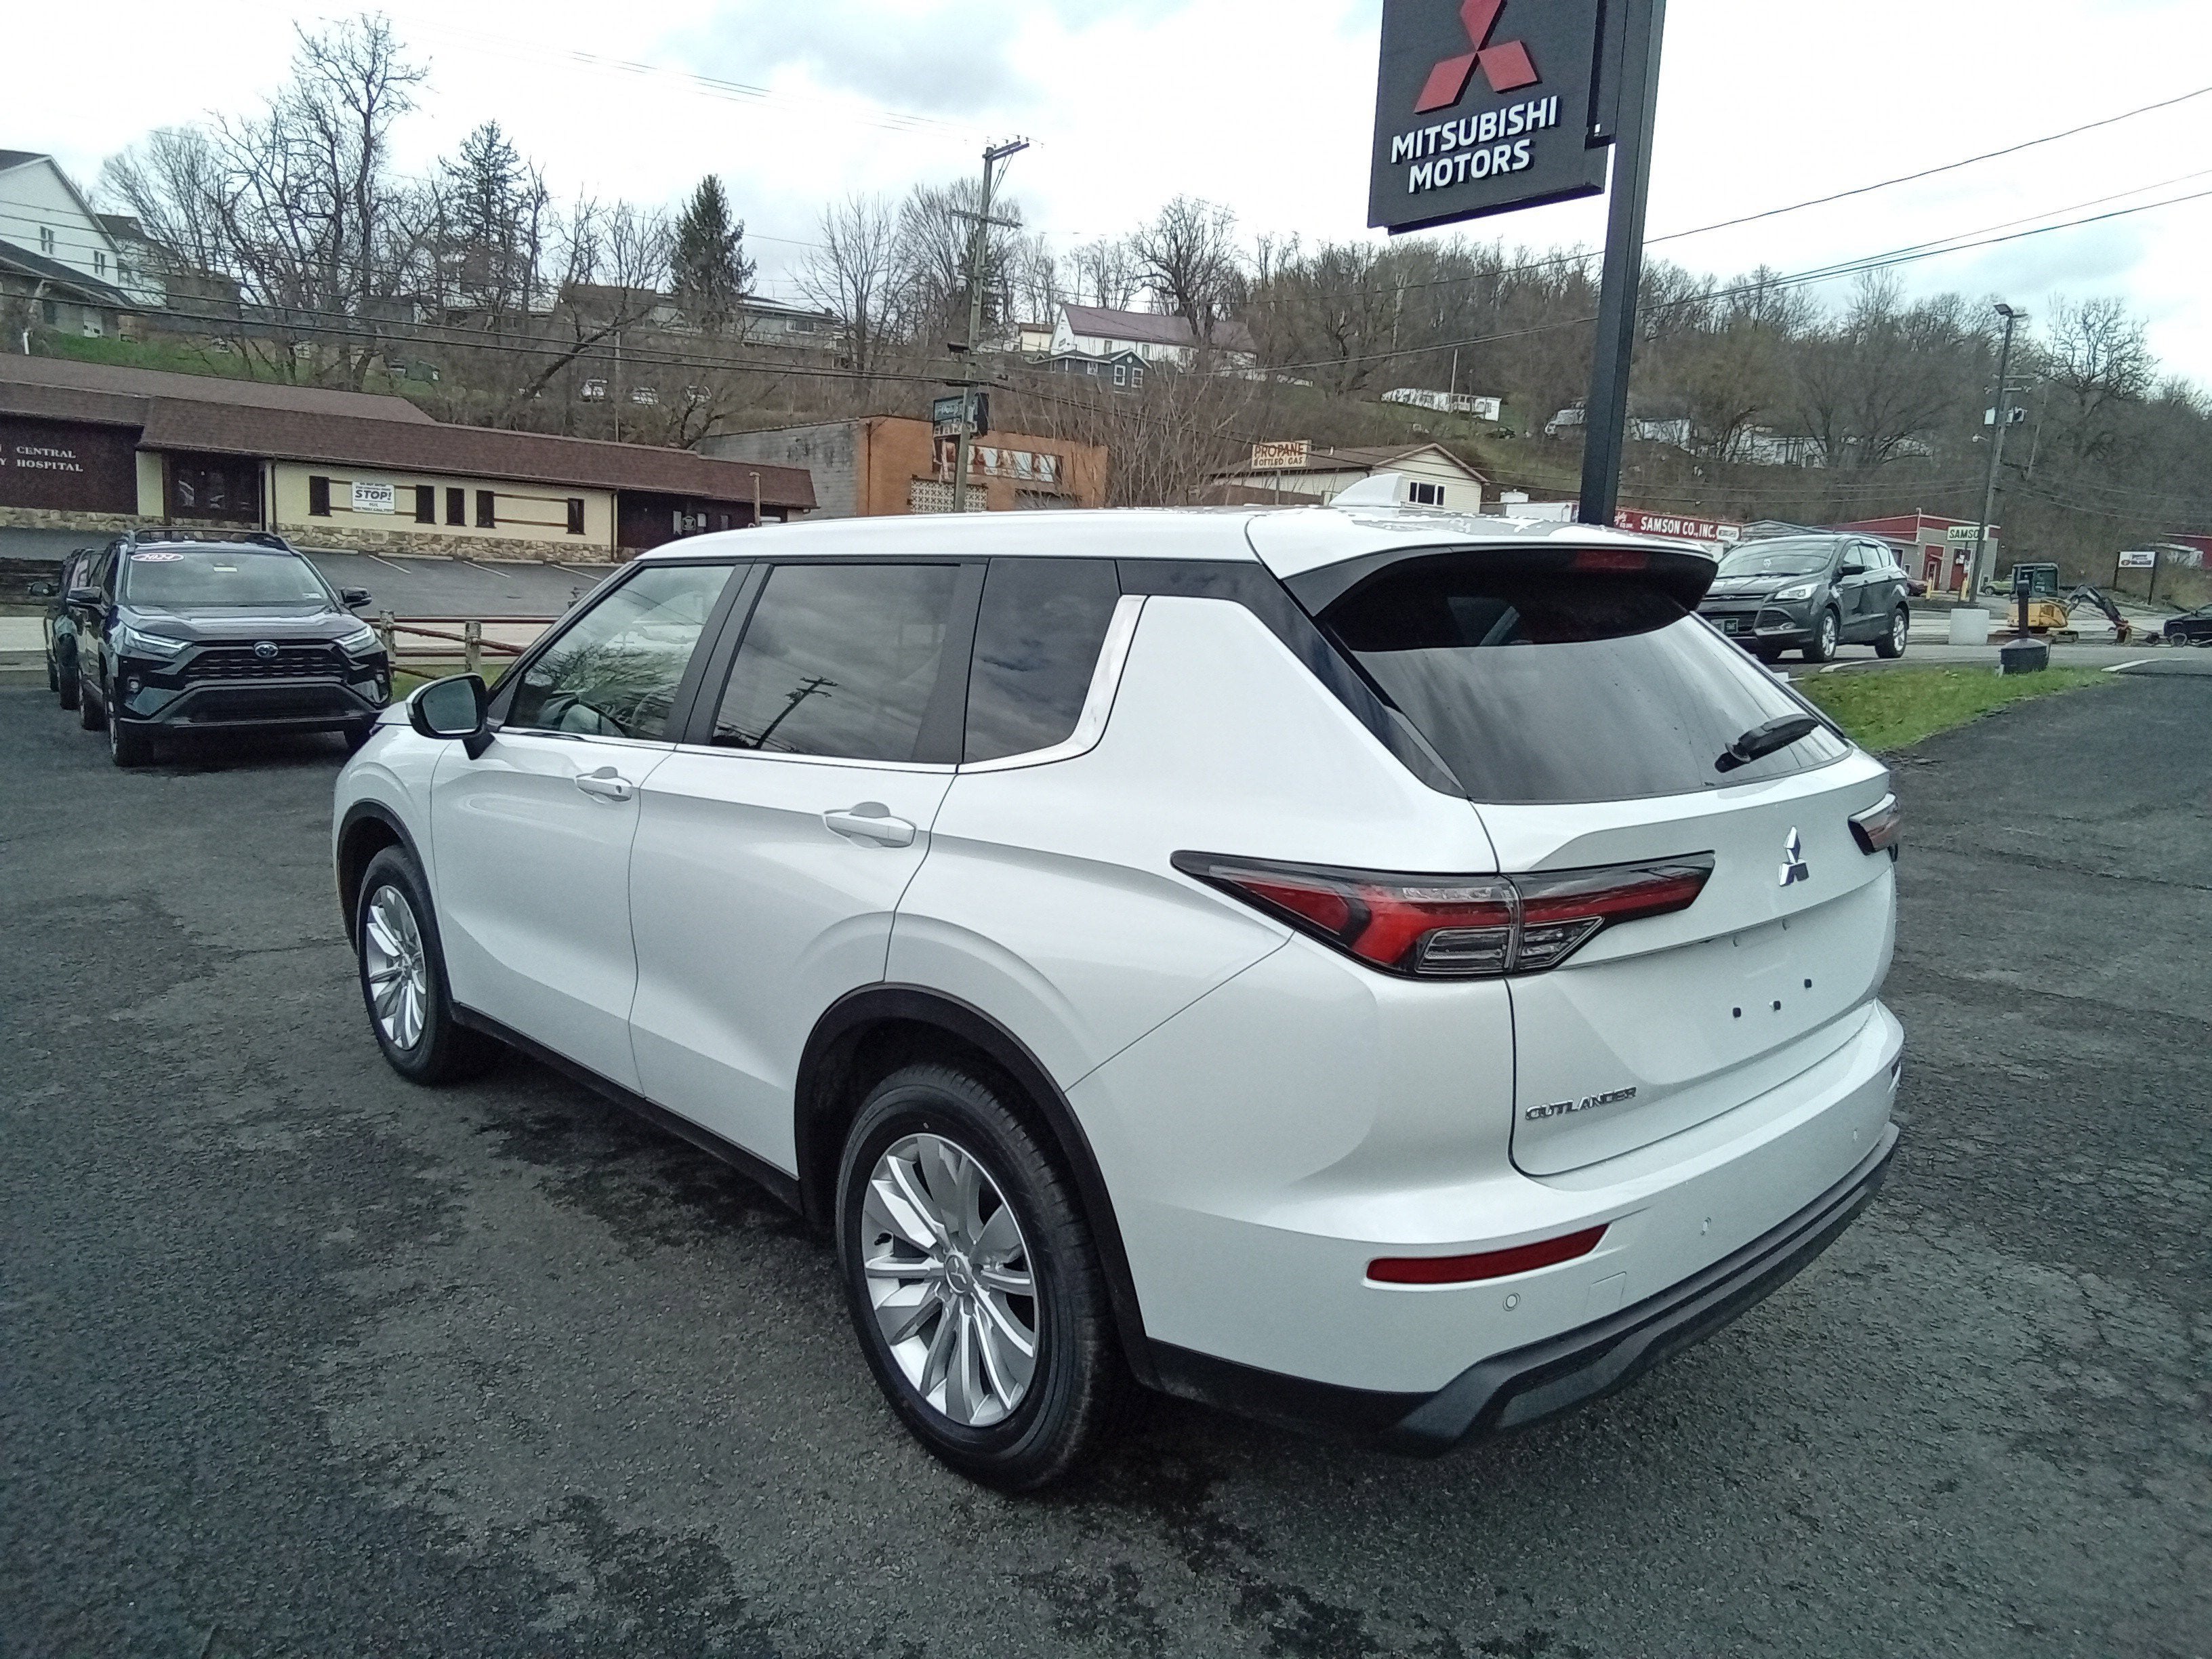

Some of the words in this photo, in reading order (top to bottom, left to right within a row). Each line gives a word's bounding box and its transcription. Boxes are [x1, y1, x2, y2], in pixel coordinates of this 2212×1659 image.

[1391, 95, 1558, 164] MITSUBISHI
[1408, 138, 1530, 194] MOTORS
[16, 446, 76, 459] CENTRAL
[1254, 444, 1304, 458] PROPANE
[16, 459, 83, 472] HOSPITAL
[1288, 456, 1303, 465] GAS
[354, 489, 392, 501] STOP!
[1640, 516, 1681, 534] SAMSON
[1949, 529, 1980, 539] SAMSO
[1525, 1086, 1637, 1121] OUTLANDER
